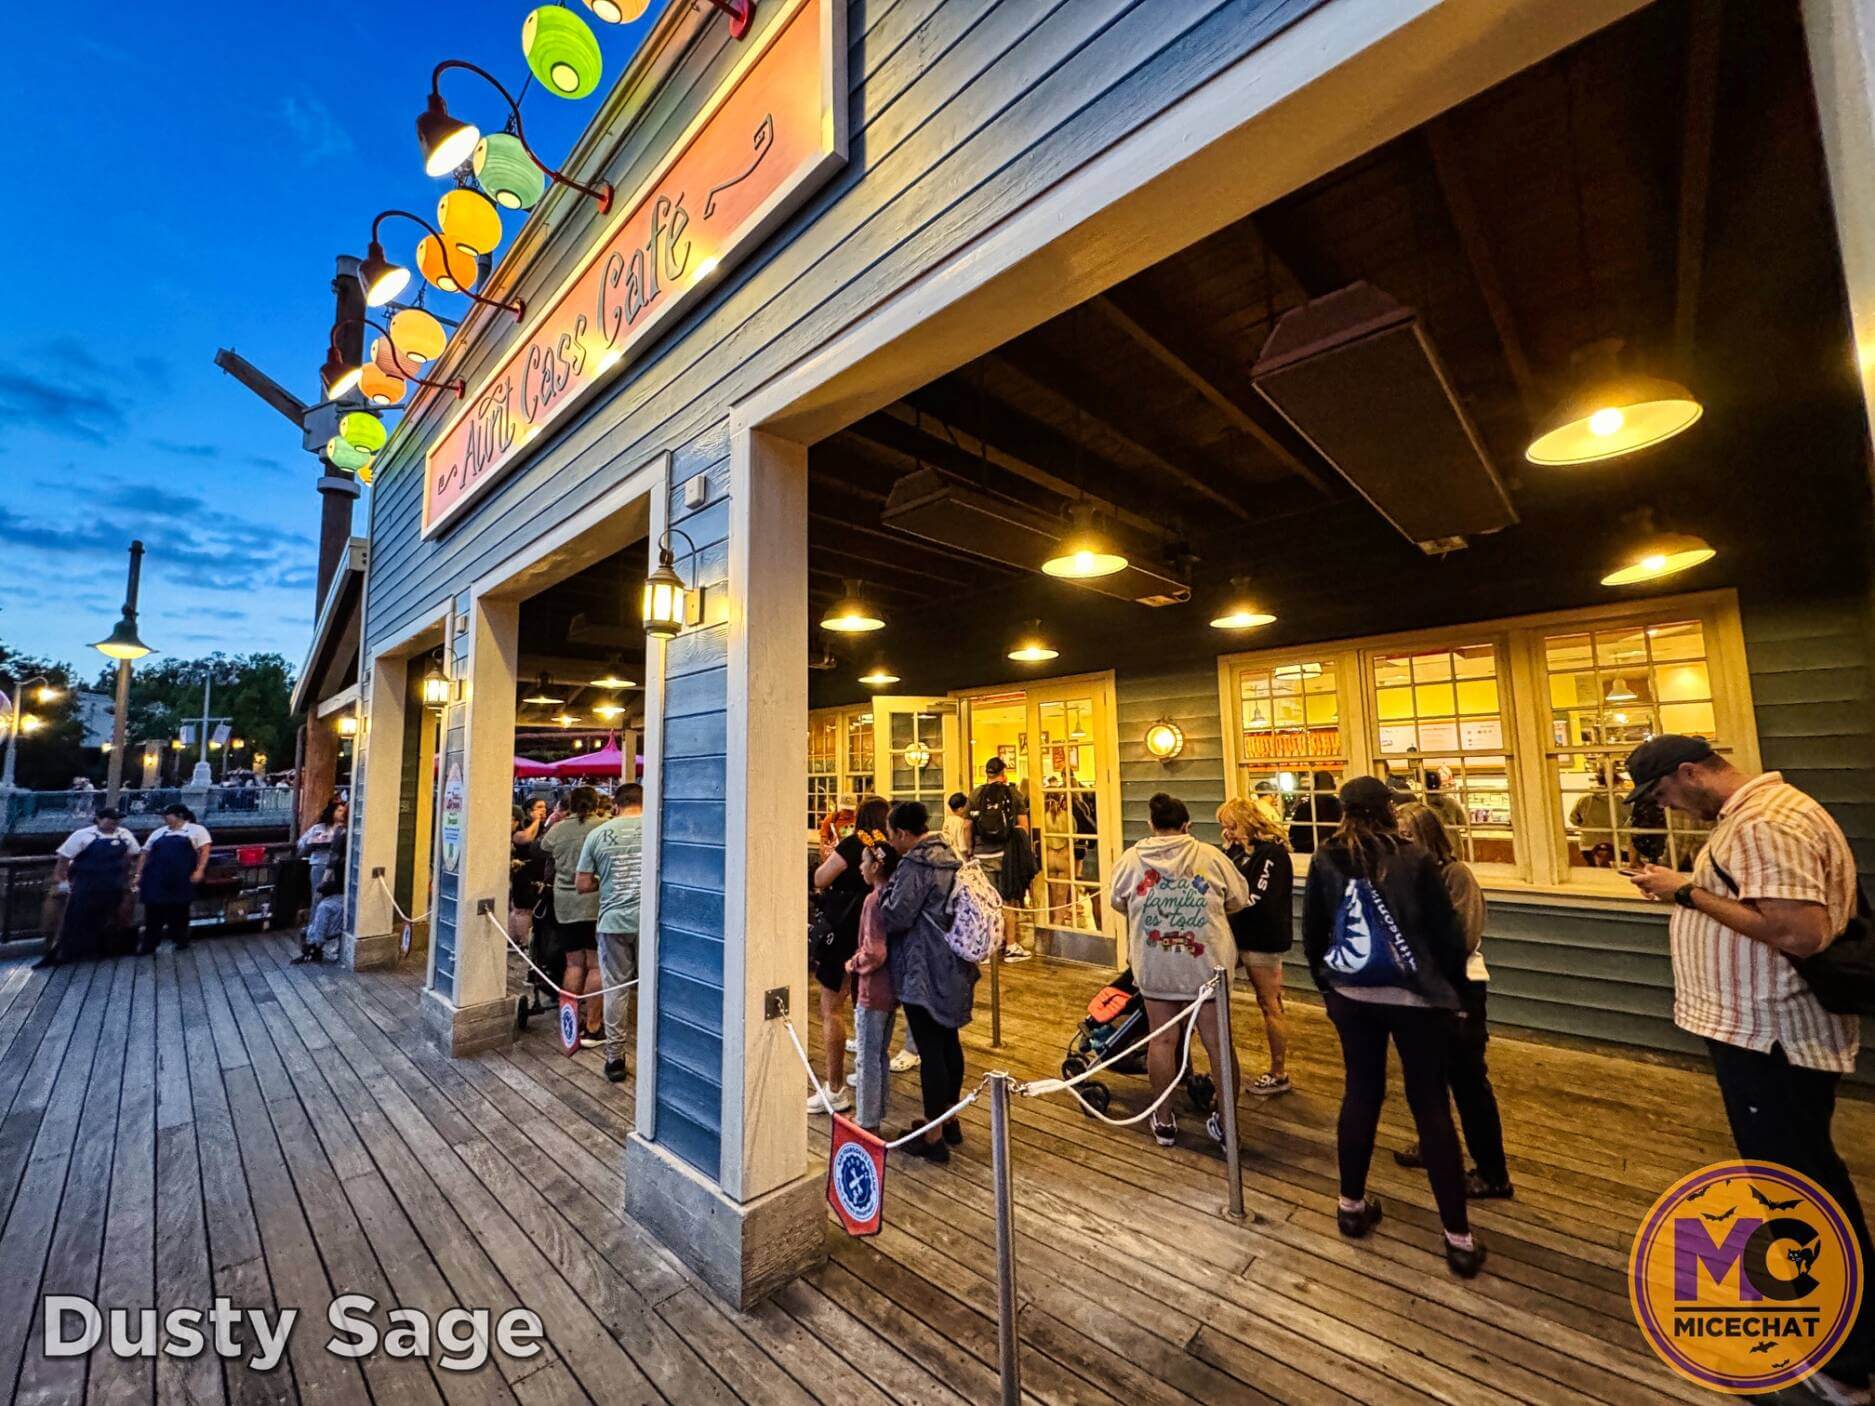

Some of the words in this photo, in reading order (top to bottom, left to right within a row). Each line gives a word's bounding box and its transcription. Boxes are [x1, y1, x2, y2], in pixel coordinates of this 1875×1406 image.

[458, 376, 516, 490] Aunt
[520, 313, 588, 425] Cass
[597, 191, 692, 350] Café
[1143, 888, 1207, 914] familia
[1145, 915, 1161, 926] es
[1169, 908, 1209, 928] todo
